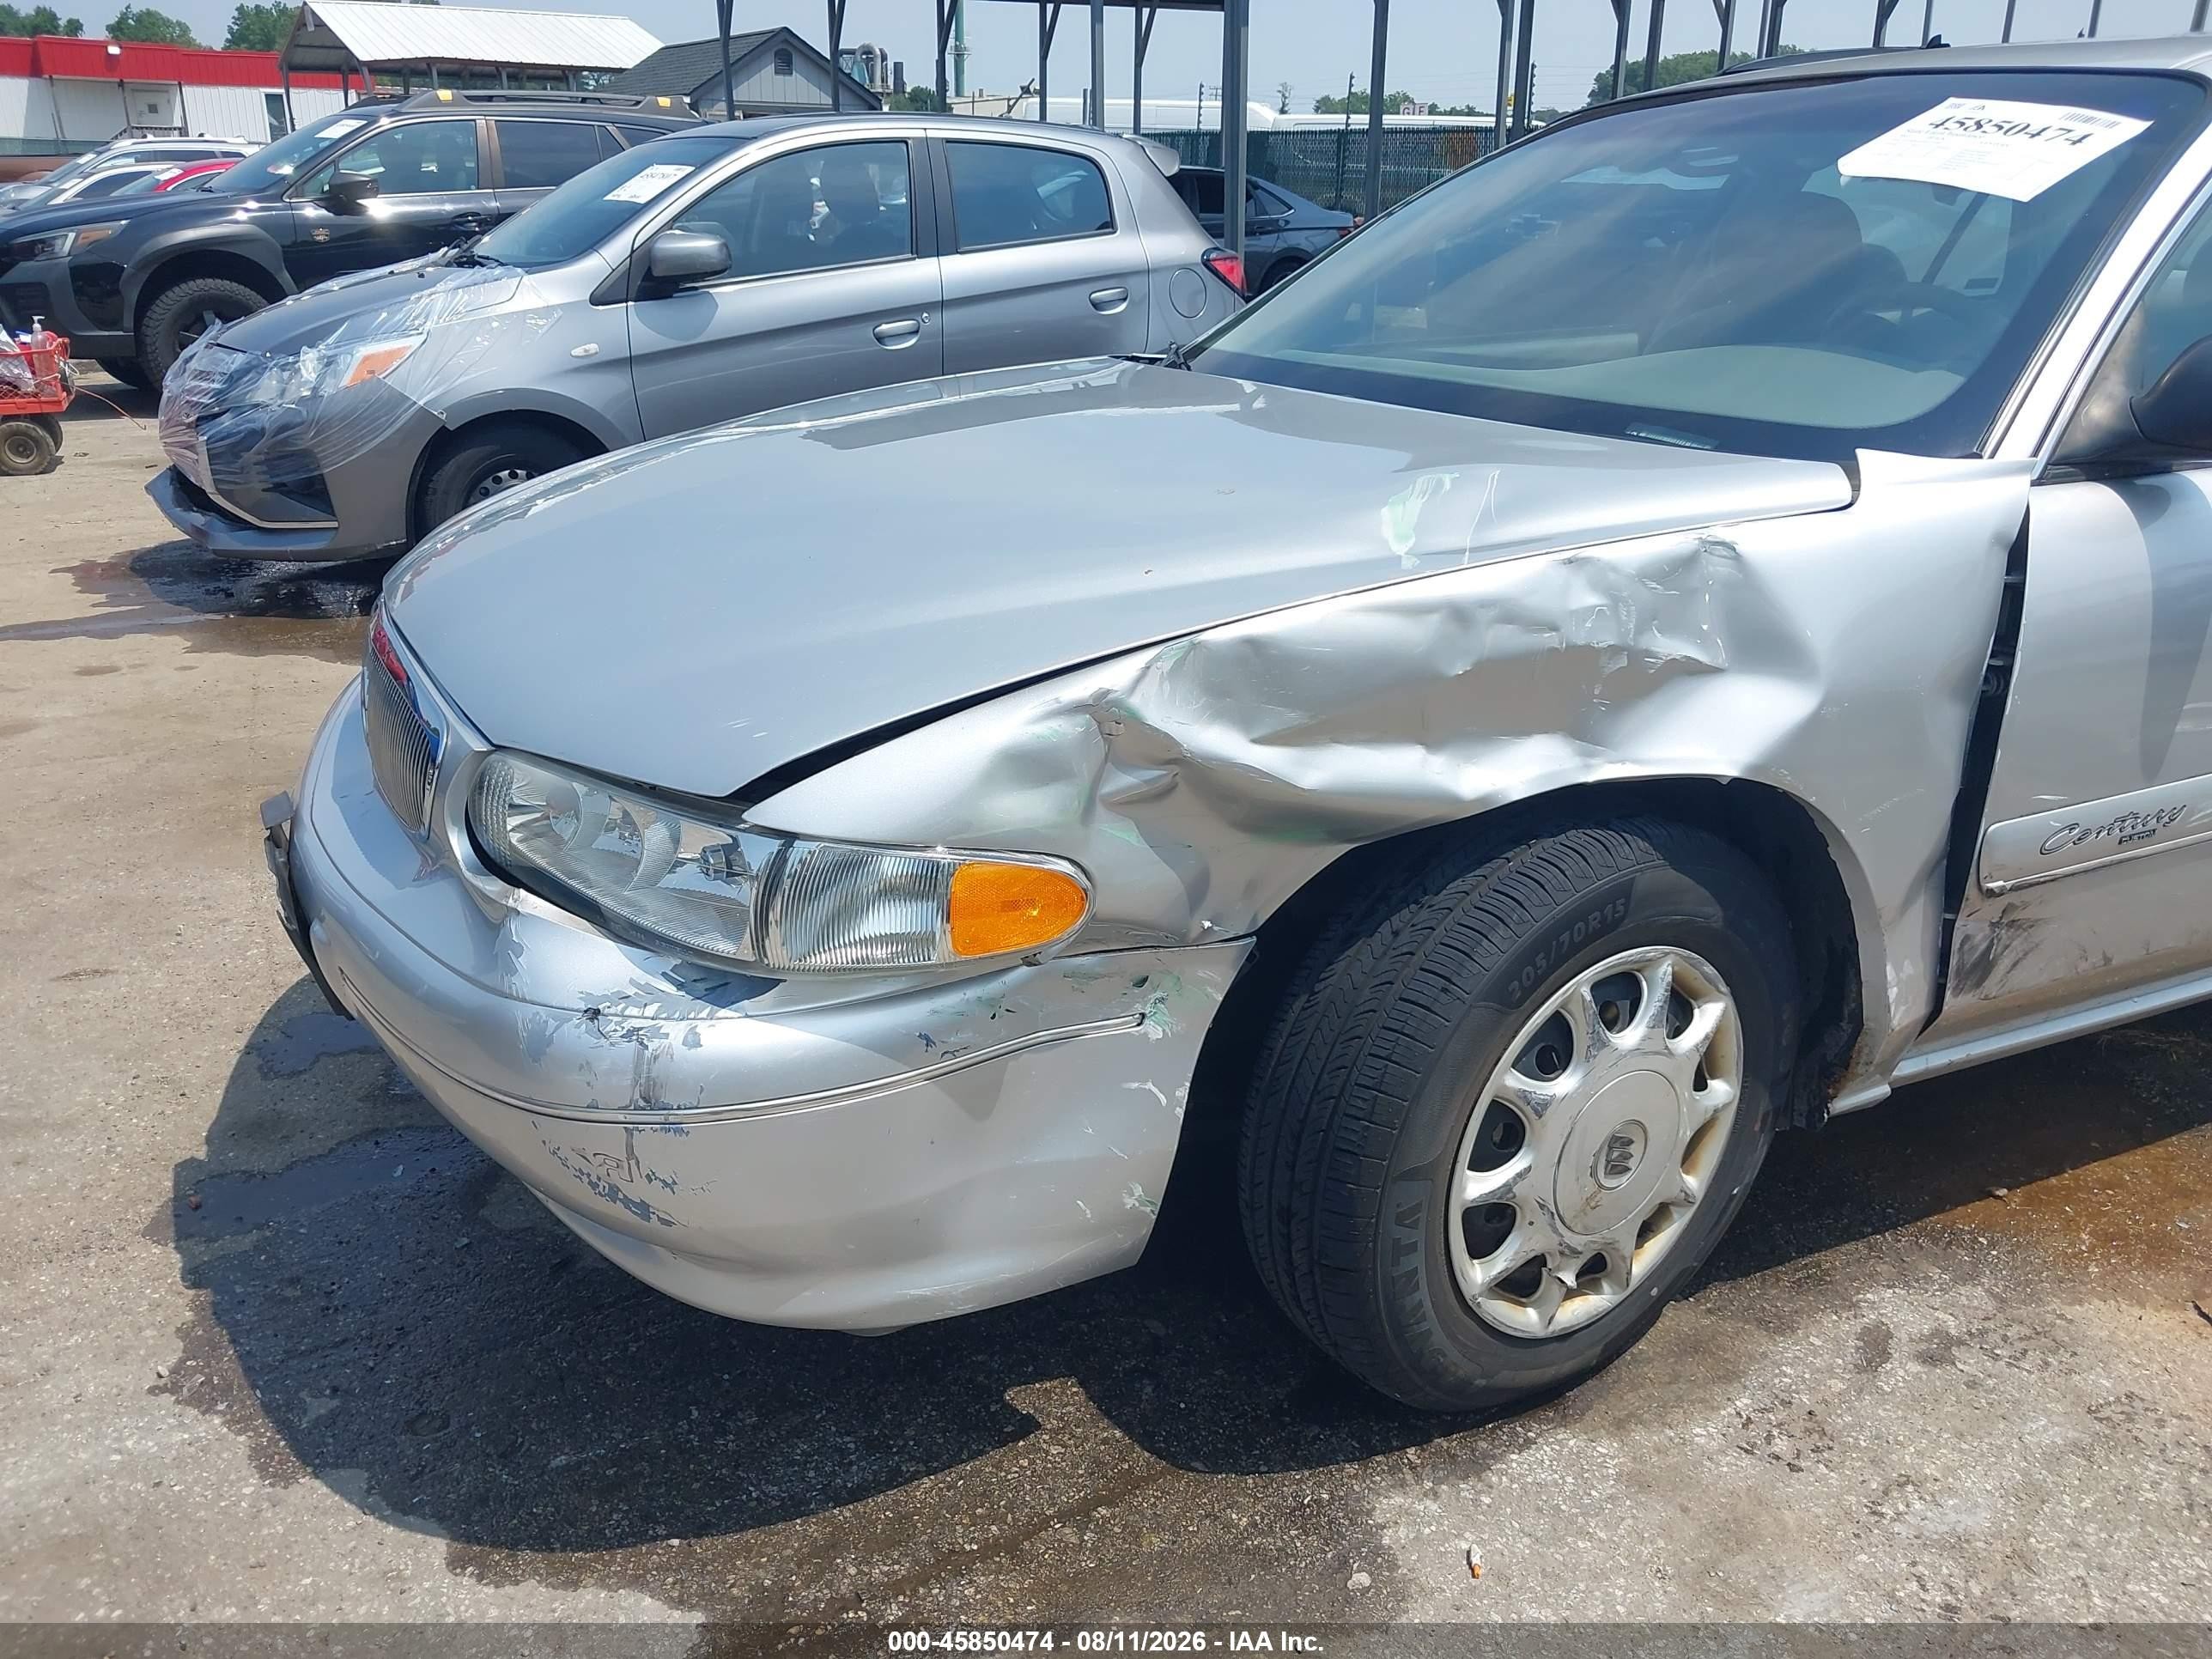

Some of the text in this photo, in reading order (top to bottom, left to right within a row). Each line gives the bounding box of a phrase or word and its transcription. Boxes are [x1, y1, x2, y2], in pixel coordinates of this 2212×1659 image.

[1929, 115, 2094, 146] 45850474
[2039, 804, 2187, 855] Century
[1508, 897, 1626, 1004] 205/70R15
